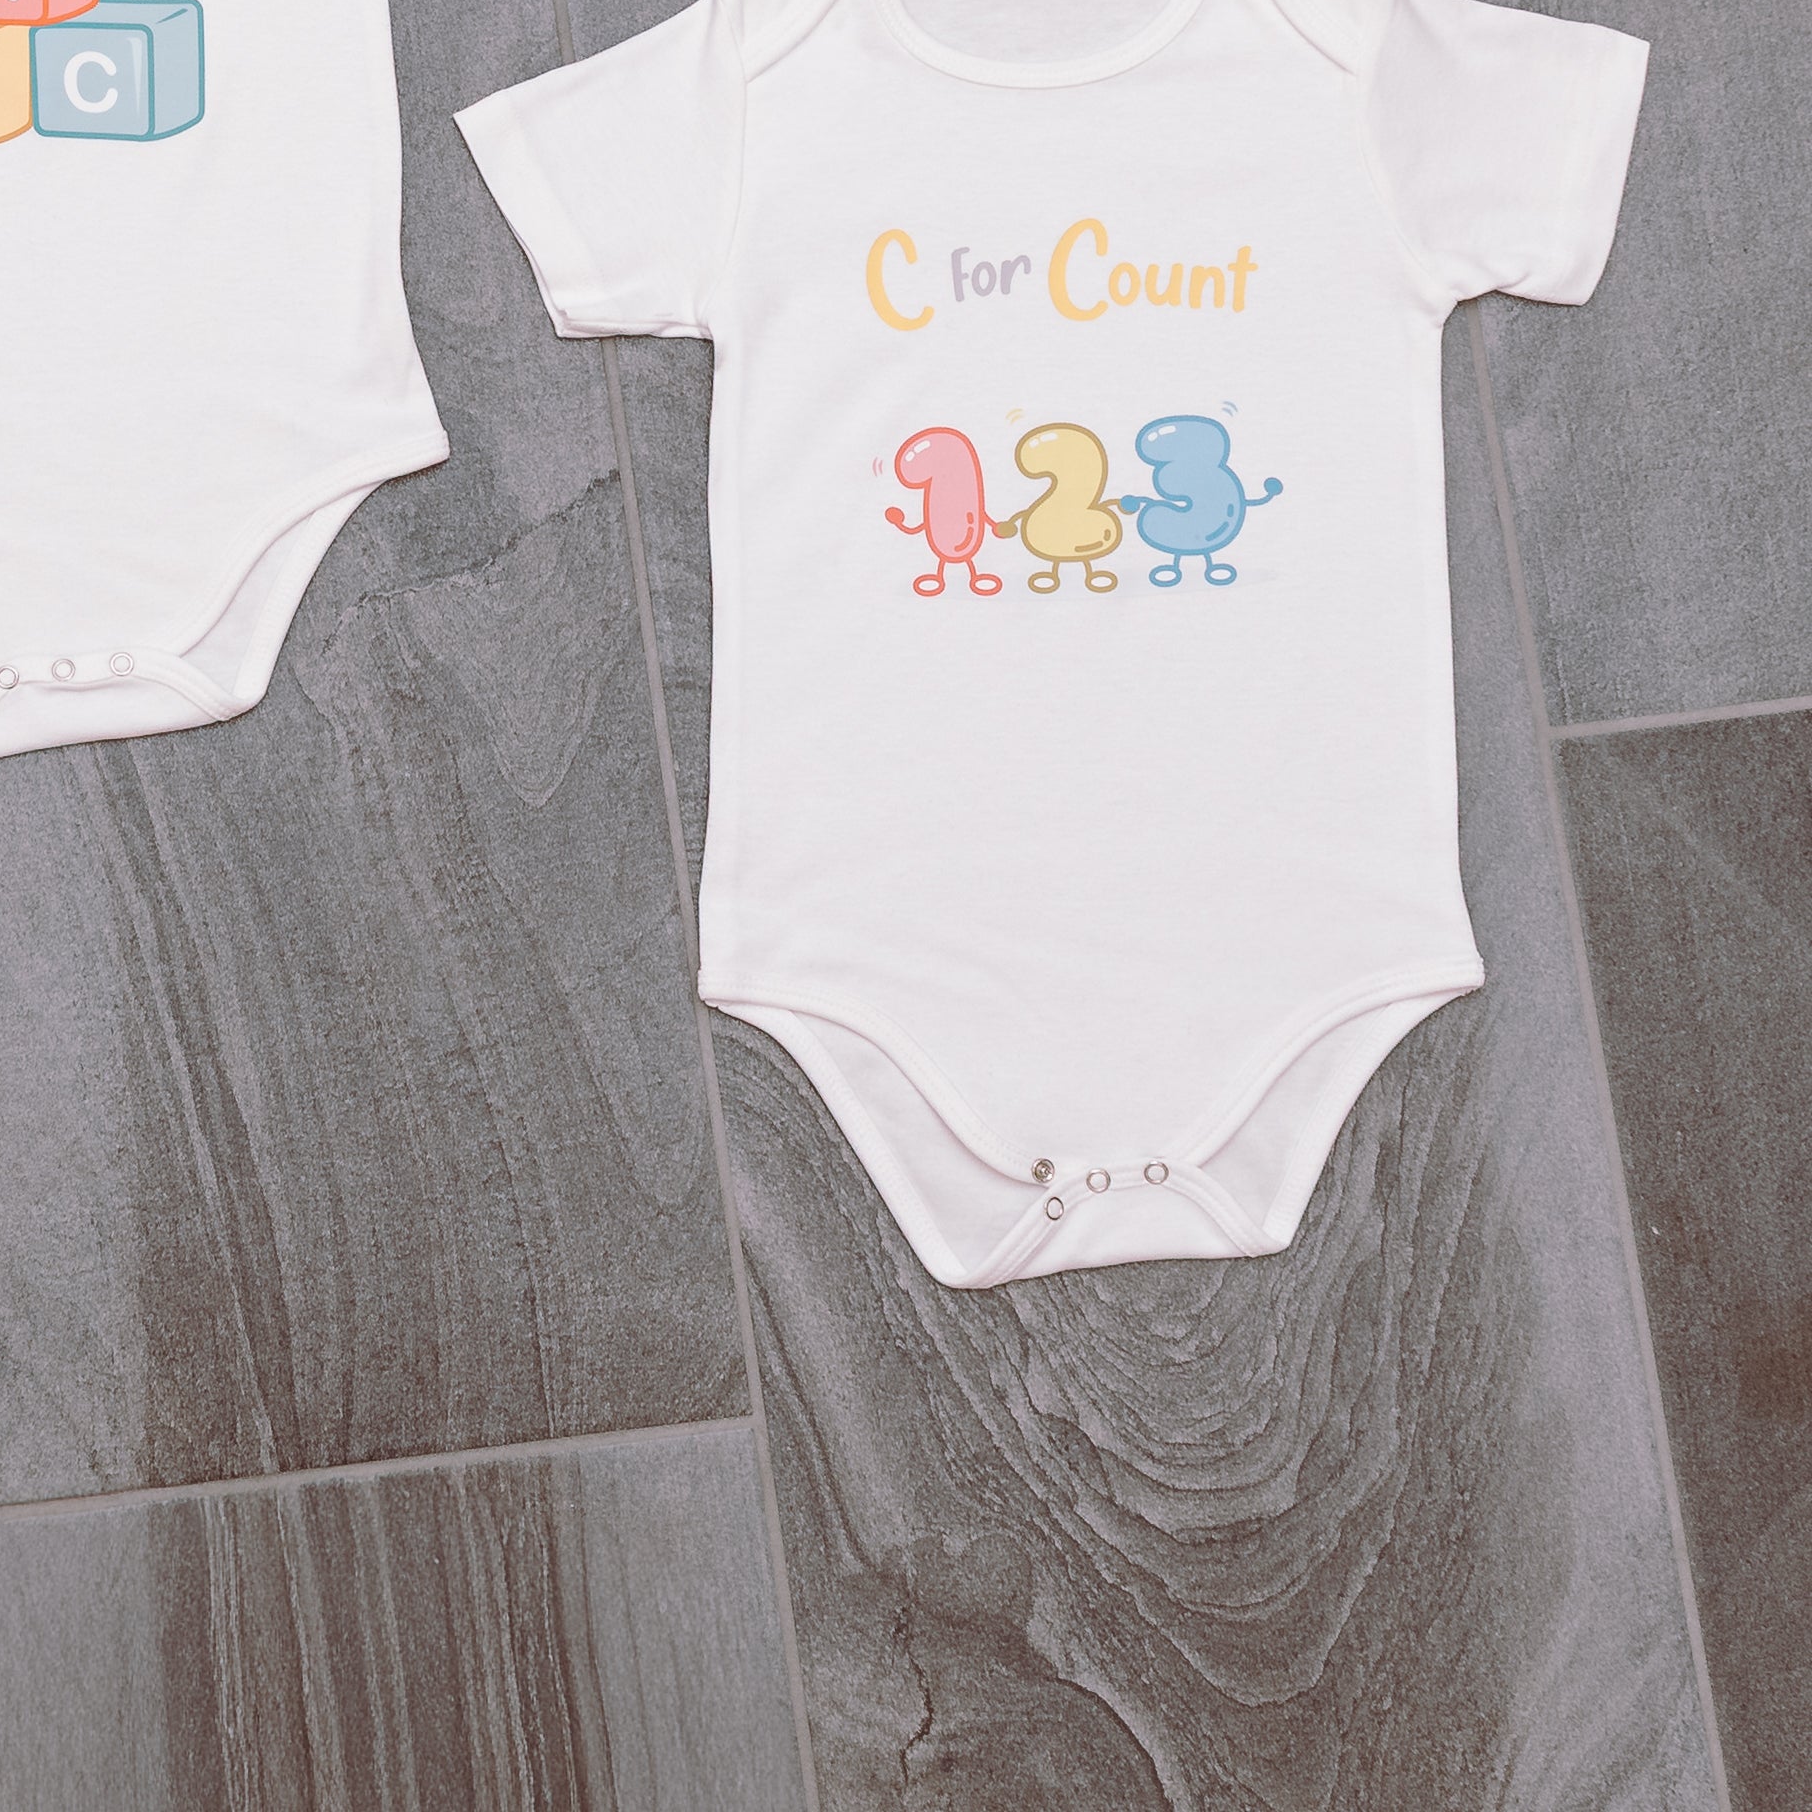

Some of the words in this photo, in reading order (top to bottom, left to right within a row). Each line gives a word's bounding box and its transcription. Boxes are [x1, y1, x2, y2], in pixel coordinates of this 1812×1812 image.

[64, 51, 118, 114] C
[865, 228, 934, 331] C
[1048, 218, 1258, 321] Count
